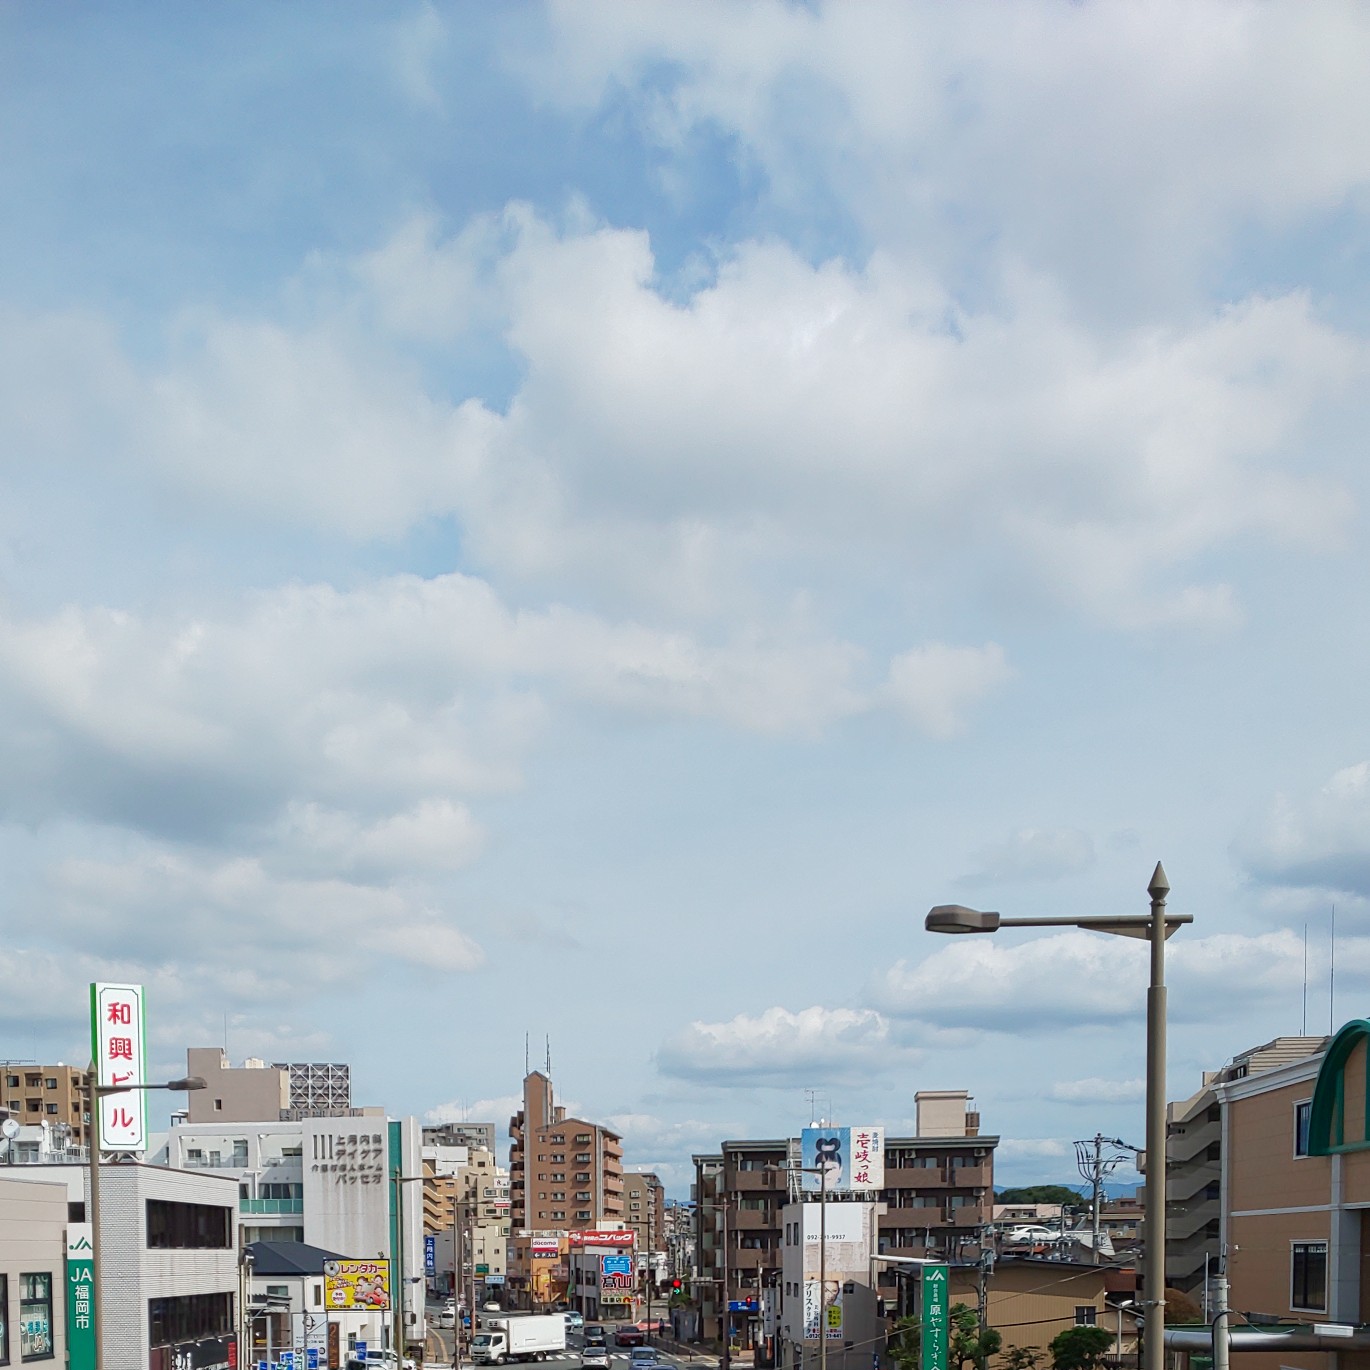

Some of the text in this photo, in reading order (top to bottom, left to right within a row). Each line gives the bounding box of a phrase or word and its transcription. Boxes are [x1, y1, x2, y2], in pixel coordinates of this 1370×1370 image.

[854, 1133, 873, 1184] 壱岐っ娘
[341, 1264, 387, 1274] レンタカー
[602, 1255, 632, 1275] 質
